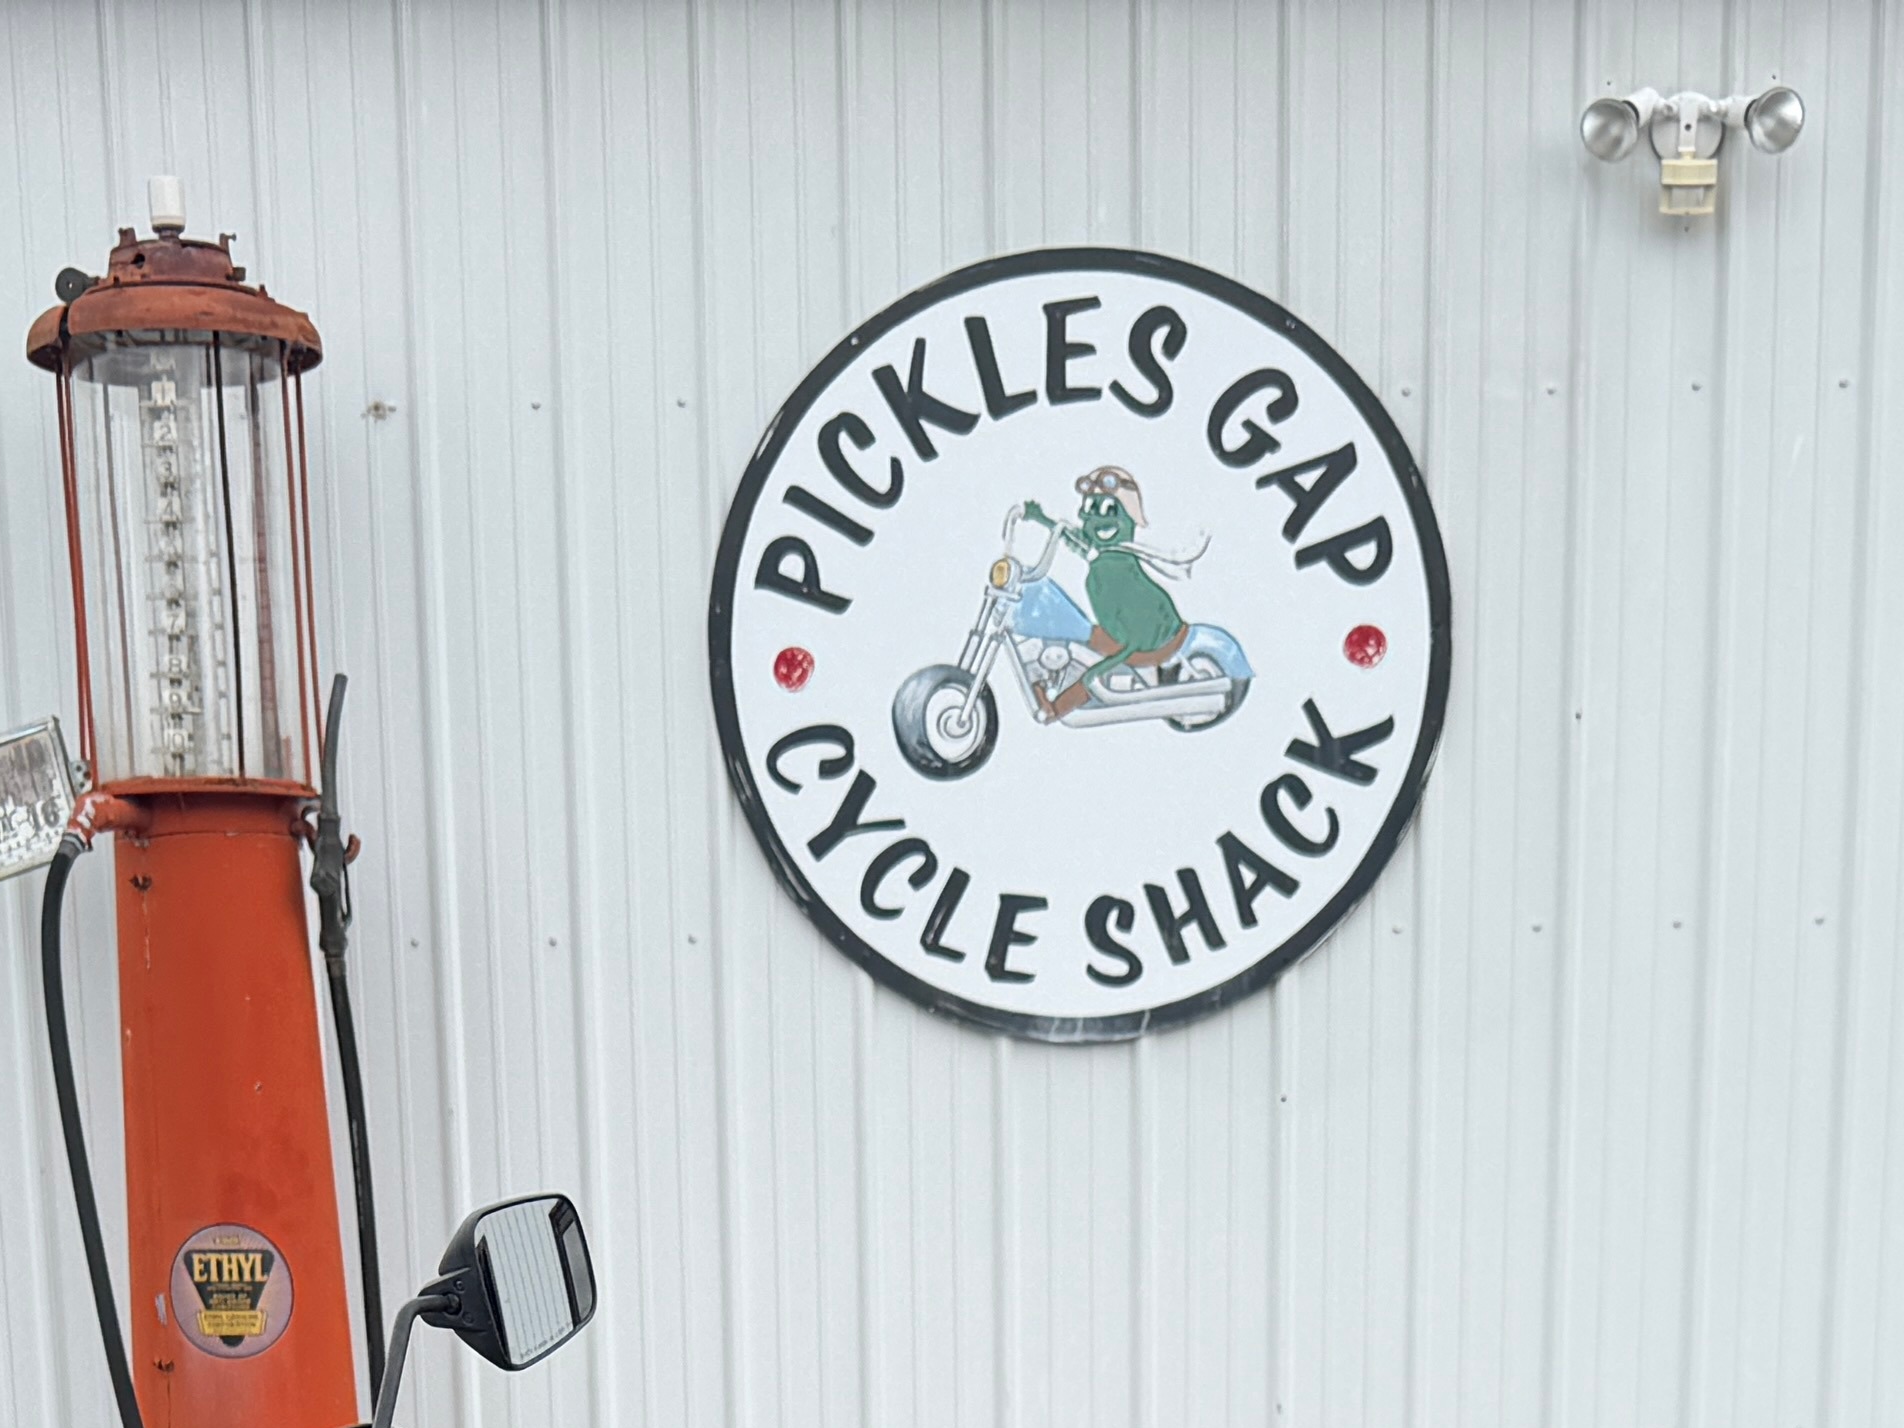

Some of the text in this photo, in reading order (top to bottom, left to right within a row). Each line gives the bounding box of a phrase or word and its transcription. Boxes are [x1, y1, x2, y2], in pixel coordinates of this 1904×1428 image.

[755, 295, 1394, 616] PICKLES GAP
[766, 698, 1394, 986] CYCLE SHACK
[192, 1252, 269, 1282] ETHYL
